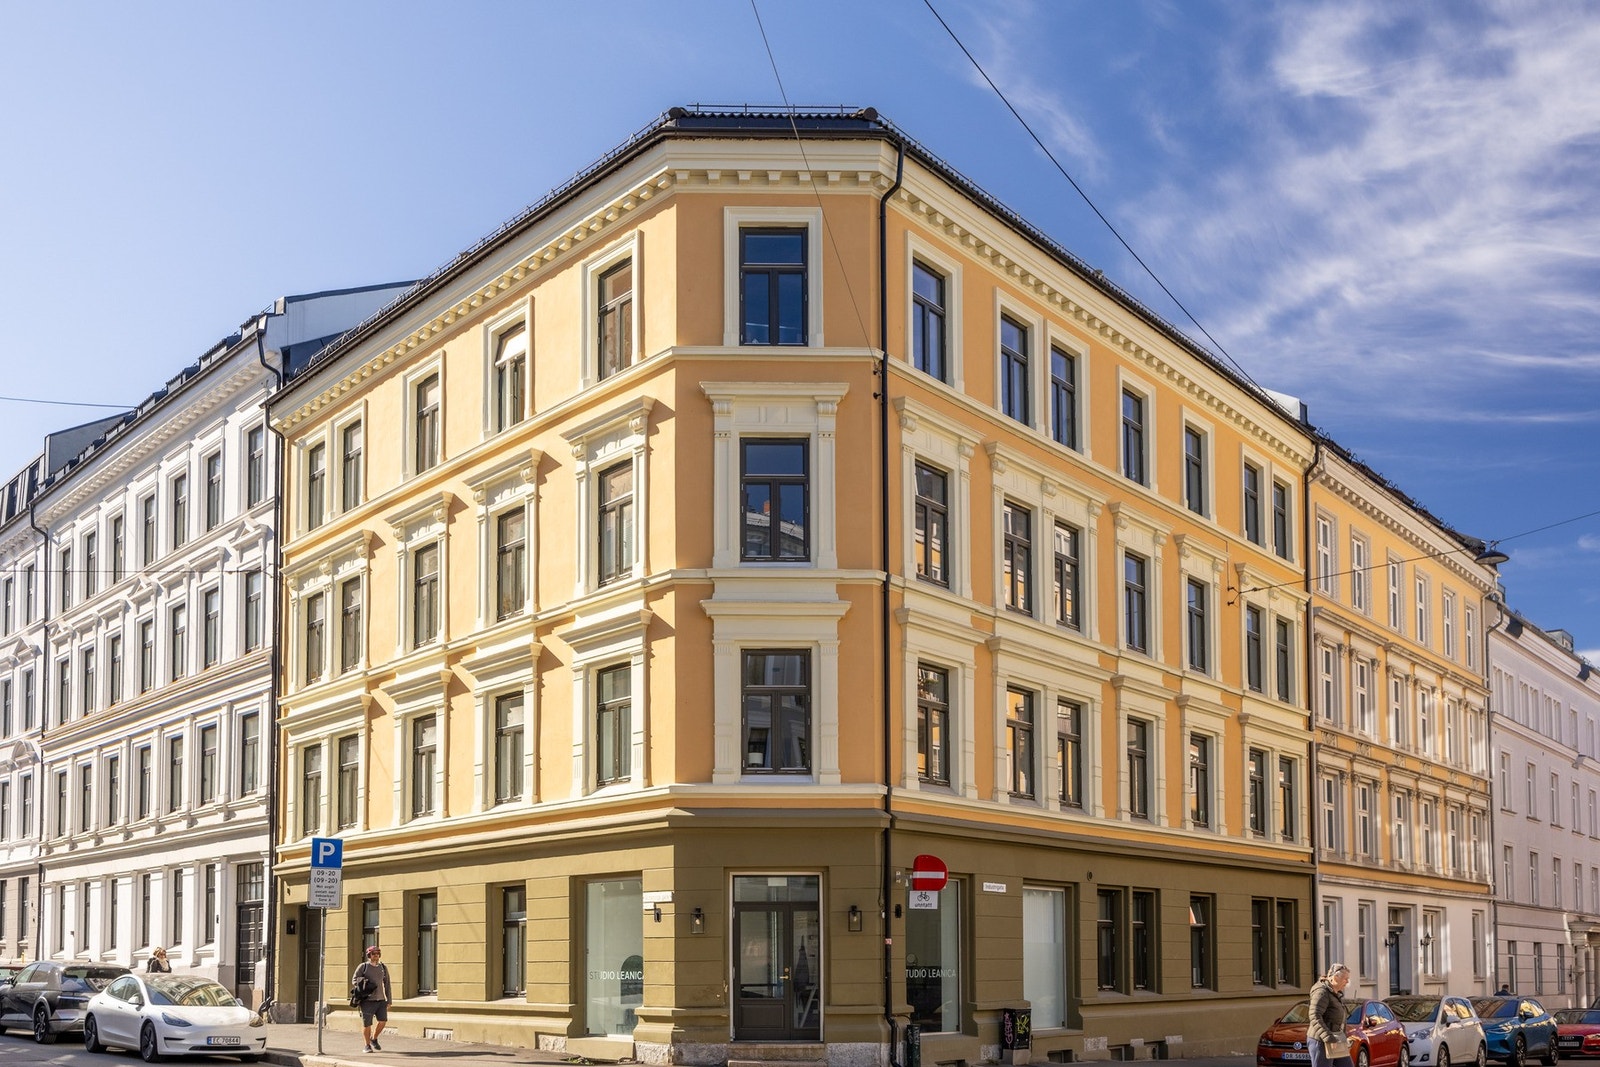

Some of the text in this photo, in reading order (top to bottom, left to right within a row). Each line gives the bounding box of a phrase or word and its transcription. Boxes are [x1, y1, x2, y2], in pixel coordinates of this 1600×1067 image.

[318, 841, 336, 865] P
[589, 970, 644, 980] STUDIO LEANIC
[905, 968, 956, 978] TUDIO LEANICA
